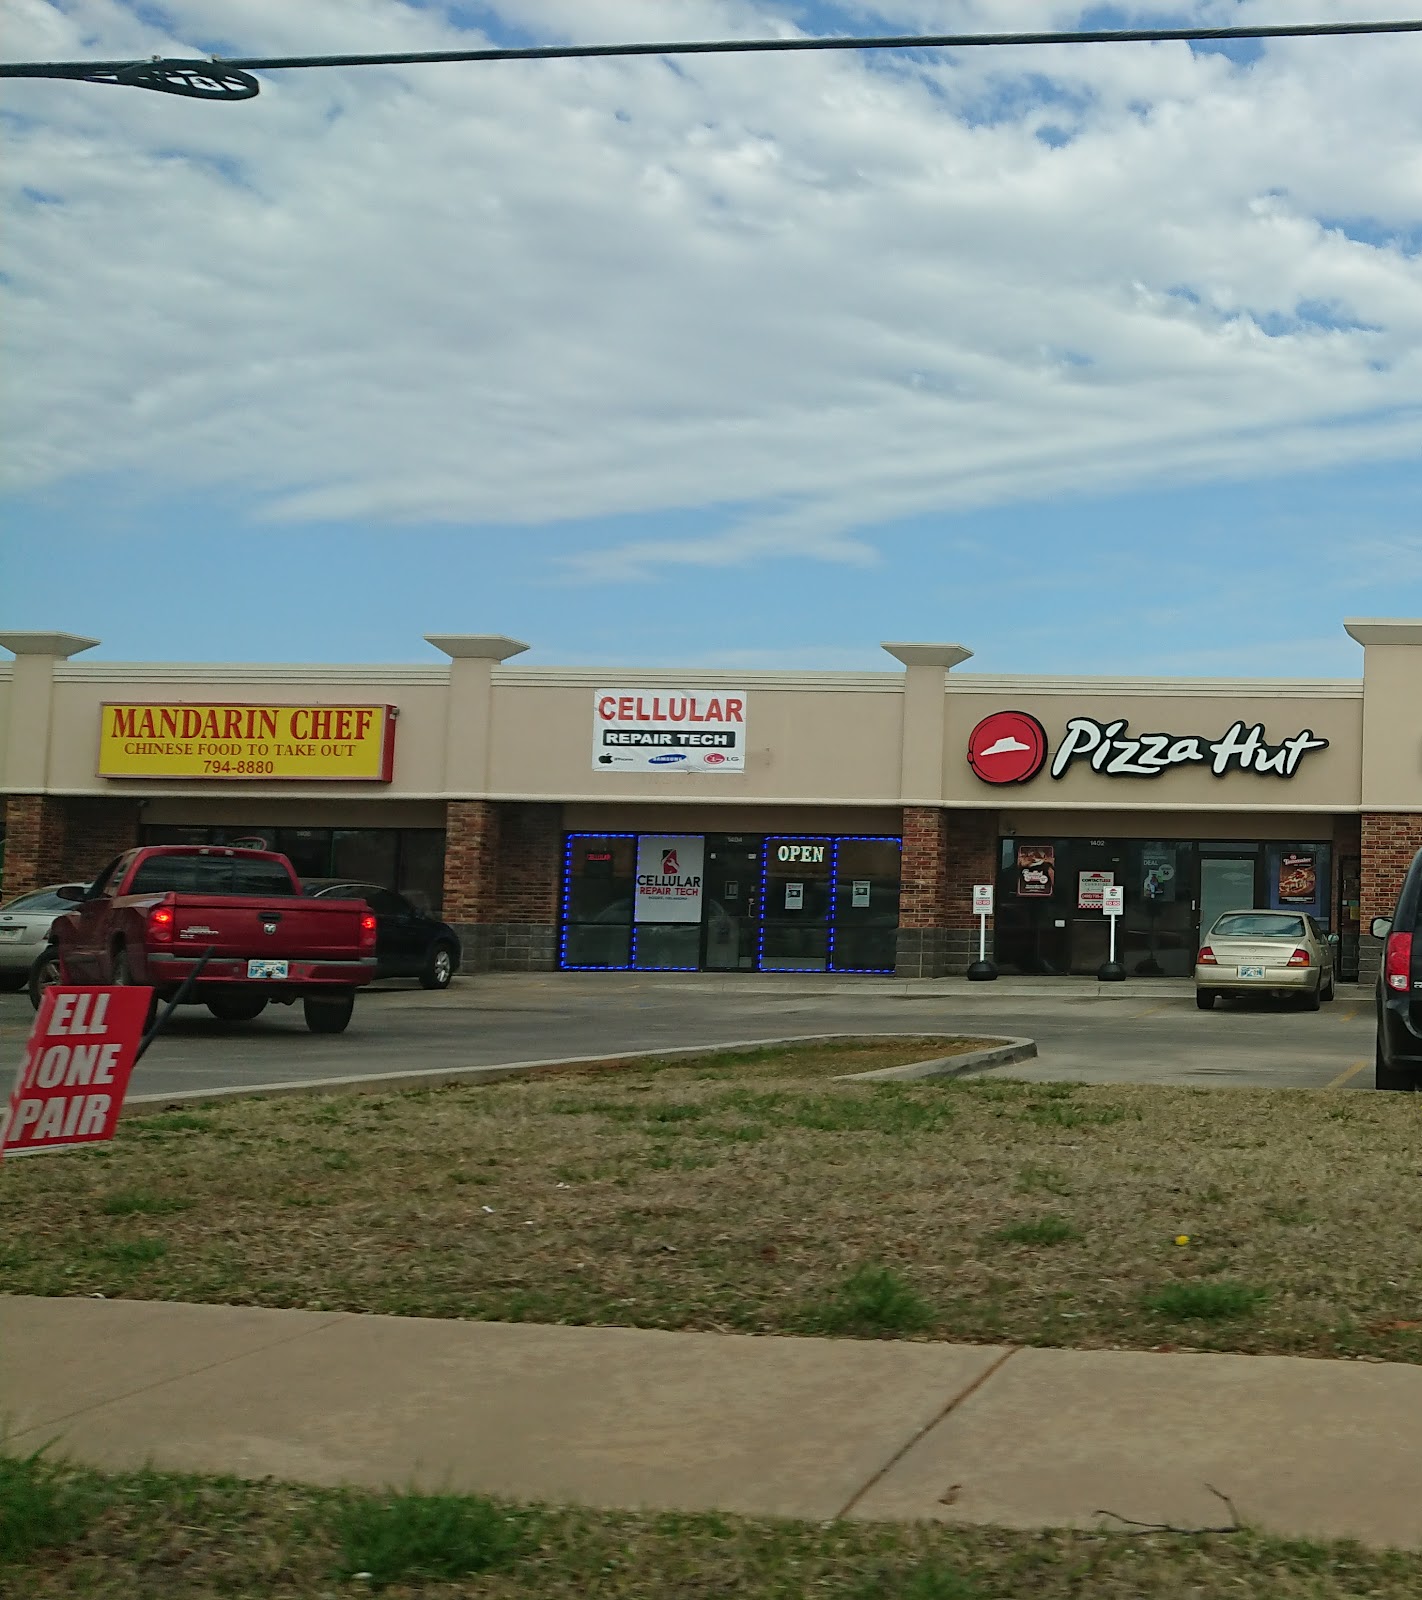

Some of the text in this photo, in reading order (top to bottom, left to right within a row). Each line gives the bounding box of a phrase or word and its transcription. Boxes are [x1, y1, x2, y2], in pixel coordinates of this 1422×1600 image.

[598, 696, 744, 723] CELLULAR
[111, 708, 373, 741] MANDARIN CHEF
[124, 742, 357, 757] CHINESE FOOD TO TAKE OUT
[605, 732, 728, 746] REPAIR TECH
[1052, 720, 1329, 776] Pizza Hut
[203, 760, 274, 774] 794-8880
[777, 845, 825, 863] OPEN
[637, 875, 701, 888] CELLULAR
[639, 887, 699, 896] REPAIR TECH
[44, 993, 112, 1036] ELL
[25, 1043, 122, 1090] ONE
[6, 1093, 113, 1142] PAIR
